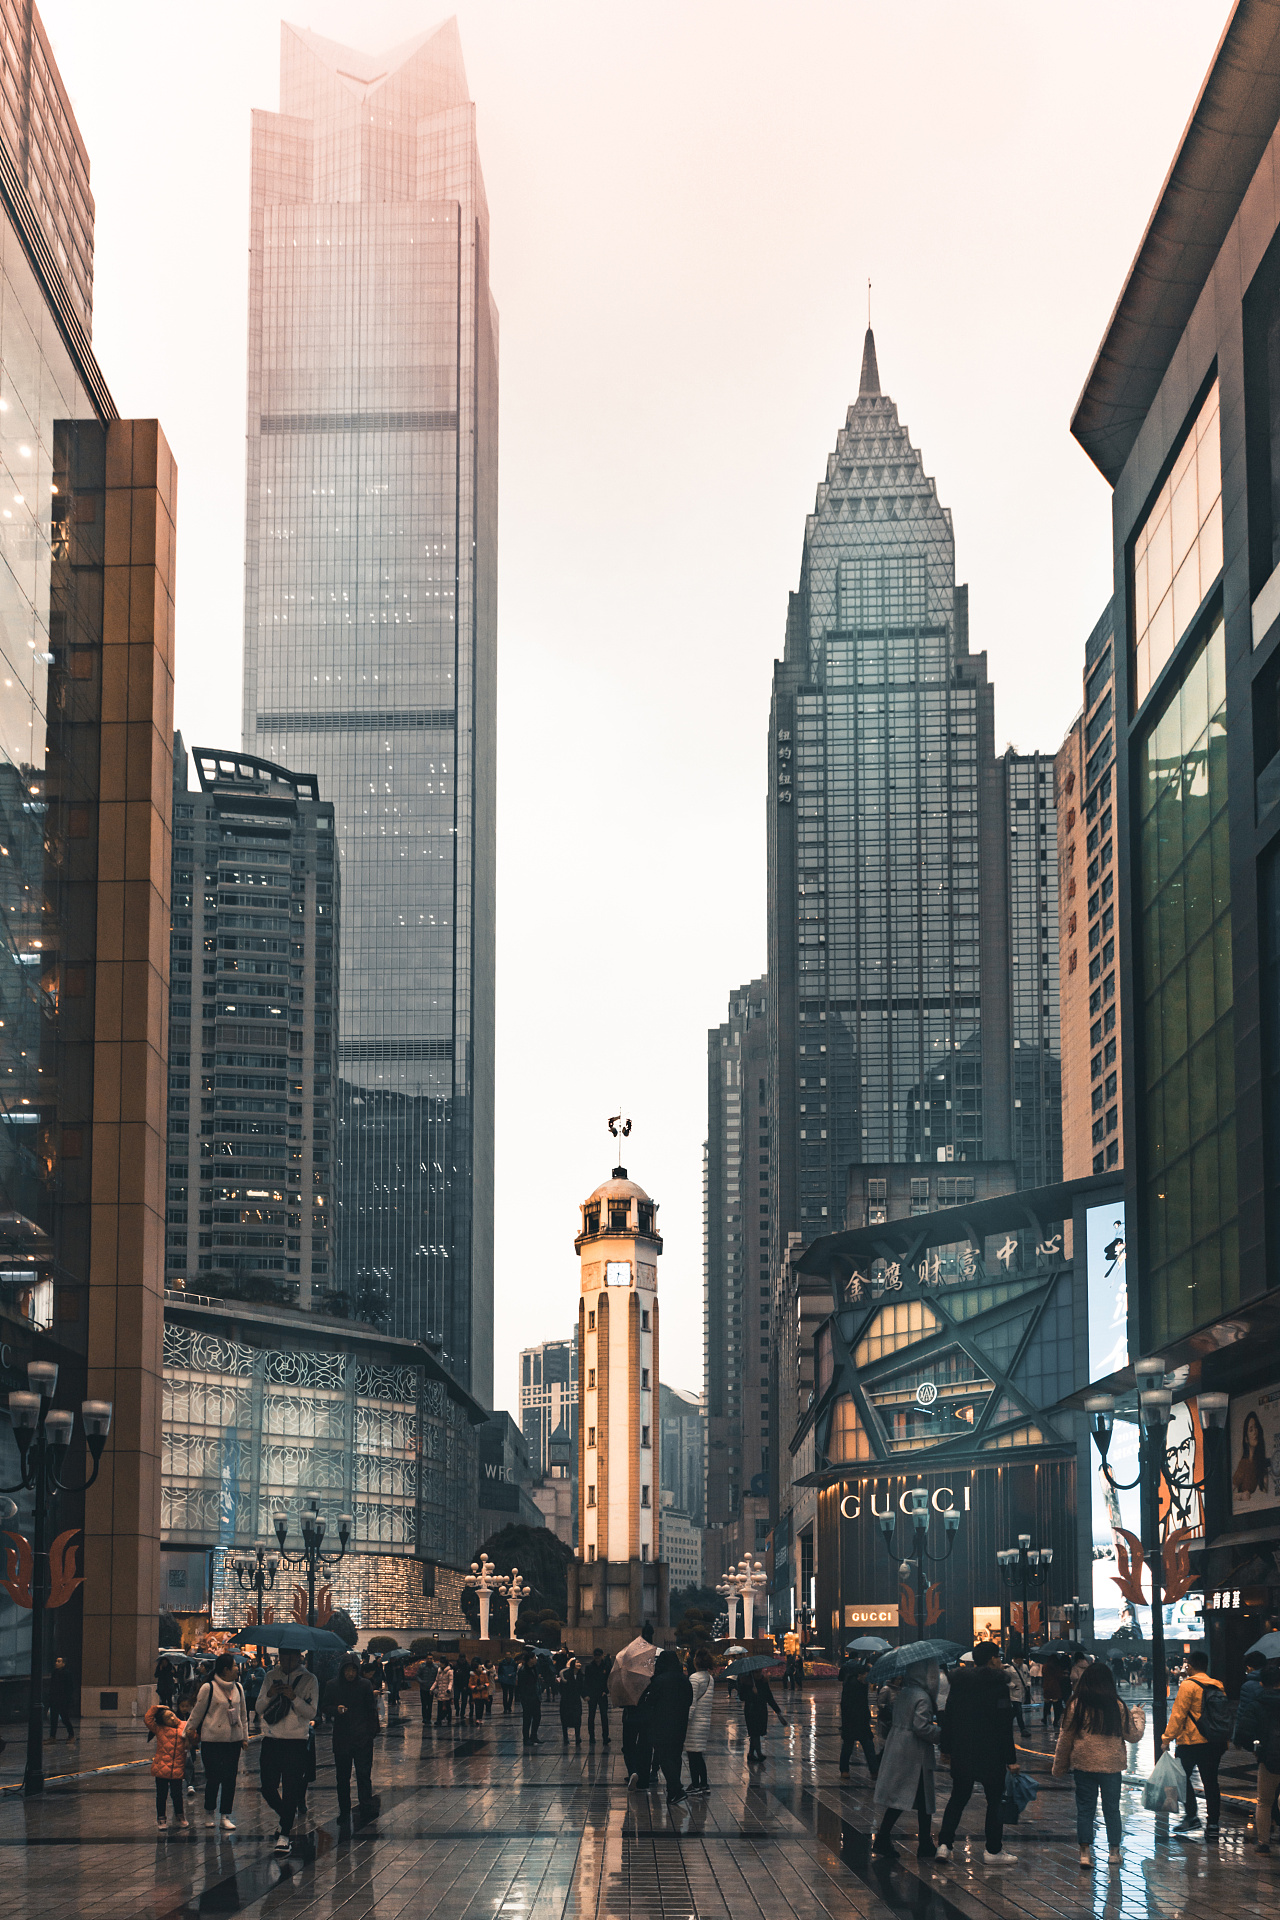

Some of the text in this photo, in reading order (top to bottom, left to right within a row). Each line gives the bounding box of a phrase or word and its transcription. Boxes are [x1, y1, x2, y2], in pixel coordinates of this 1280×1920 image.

[778, 728, 792, 803] 纽约·纽约
[845, 1234, 1062, 1302] 金鹰财富中心
[840, 1486, 971, 1519] GUCCI
[1213, 1590, 1241, 1610] 肯德基
[851, 1612, 892, 1622] GUCCI
